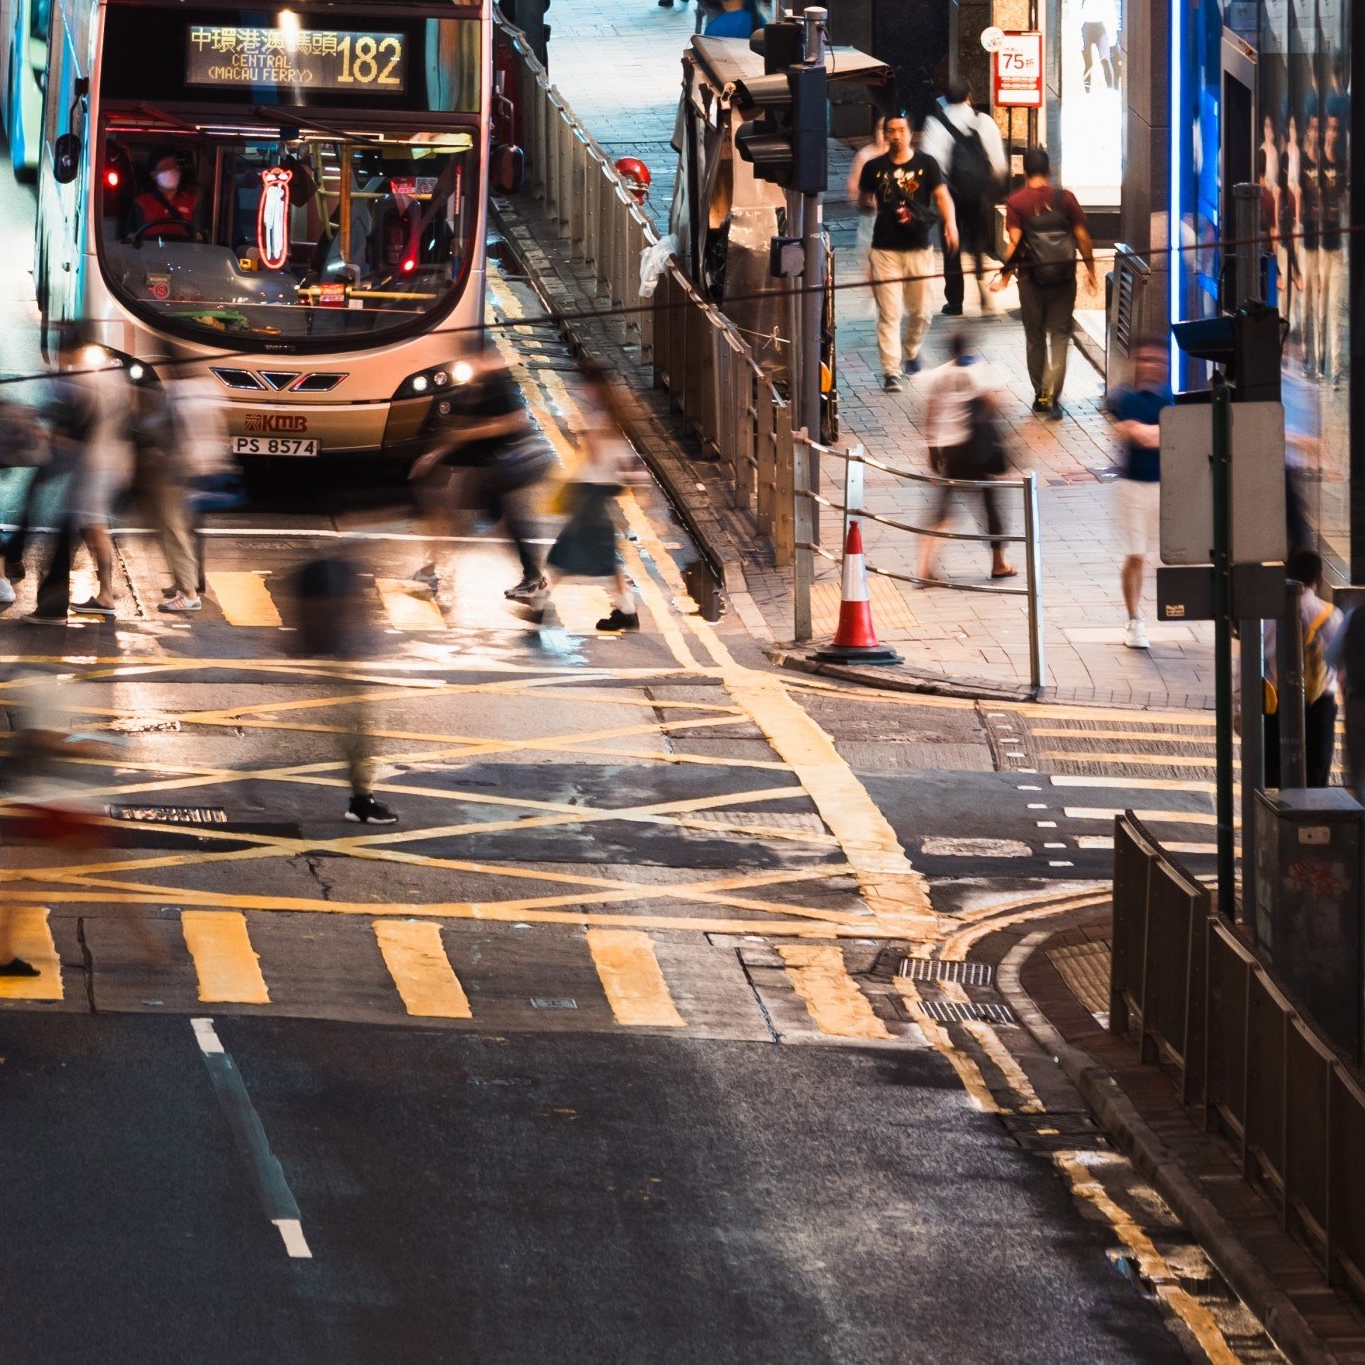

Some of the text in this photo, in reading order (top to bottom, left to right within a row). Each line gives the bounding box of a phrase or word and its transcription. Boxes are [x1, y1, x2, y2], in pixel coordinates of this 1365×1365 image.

[231, 54, 291, 69] CENTRAL
[337, 35, 402, 84] 182
[1003, 53, 1035, 70] 75折
[208, 66, 313, 83] (MACAU FERRY)
[236, 438, 315, 456] PS 8574
